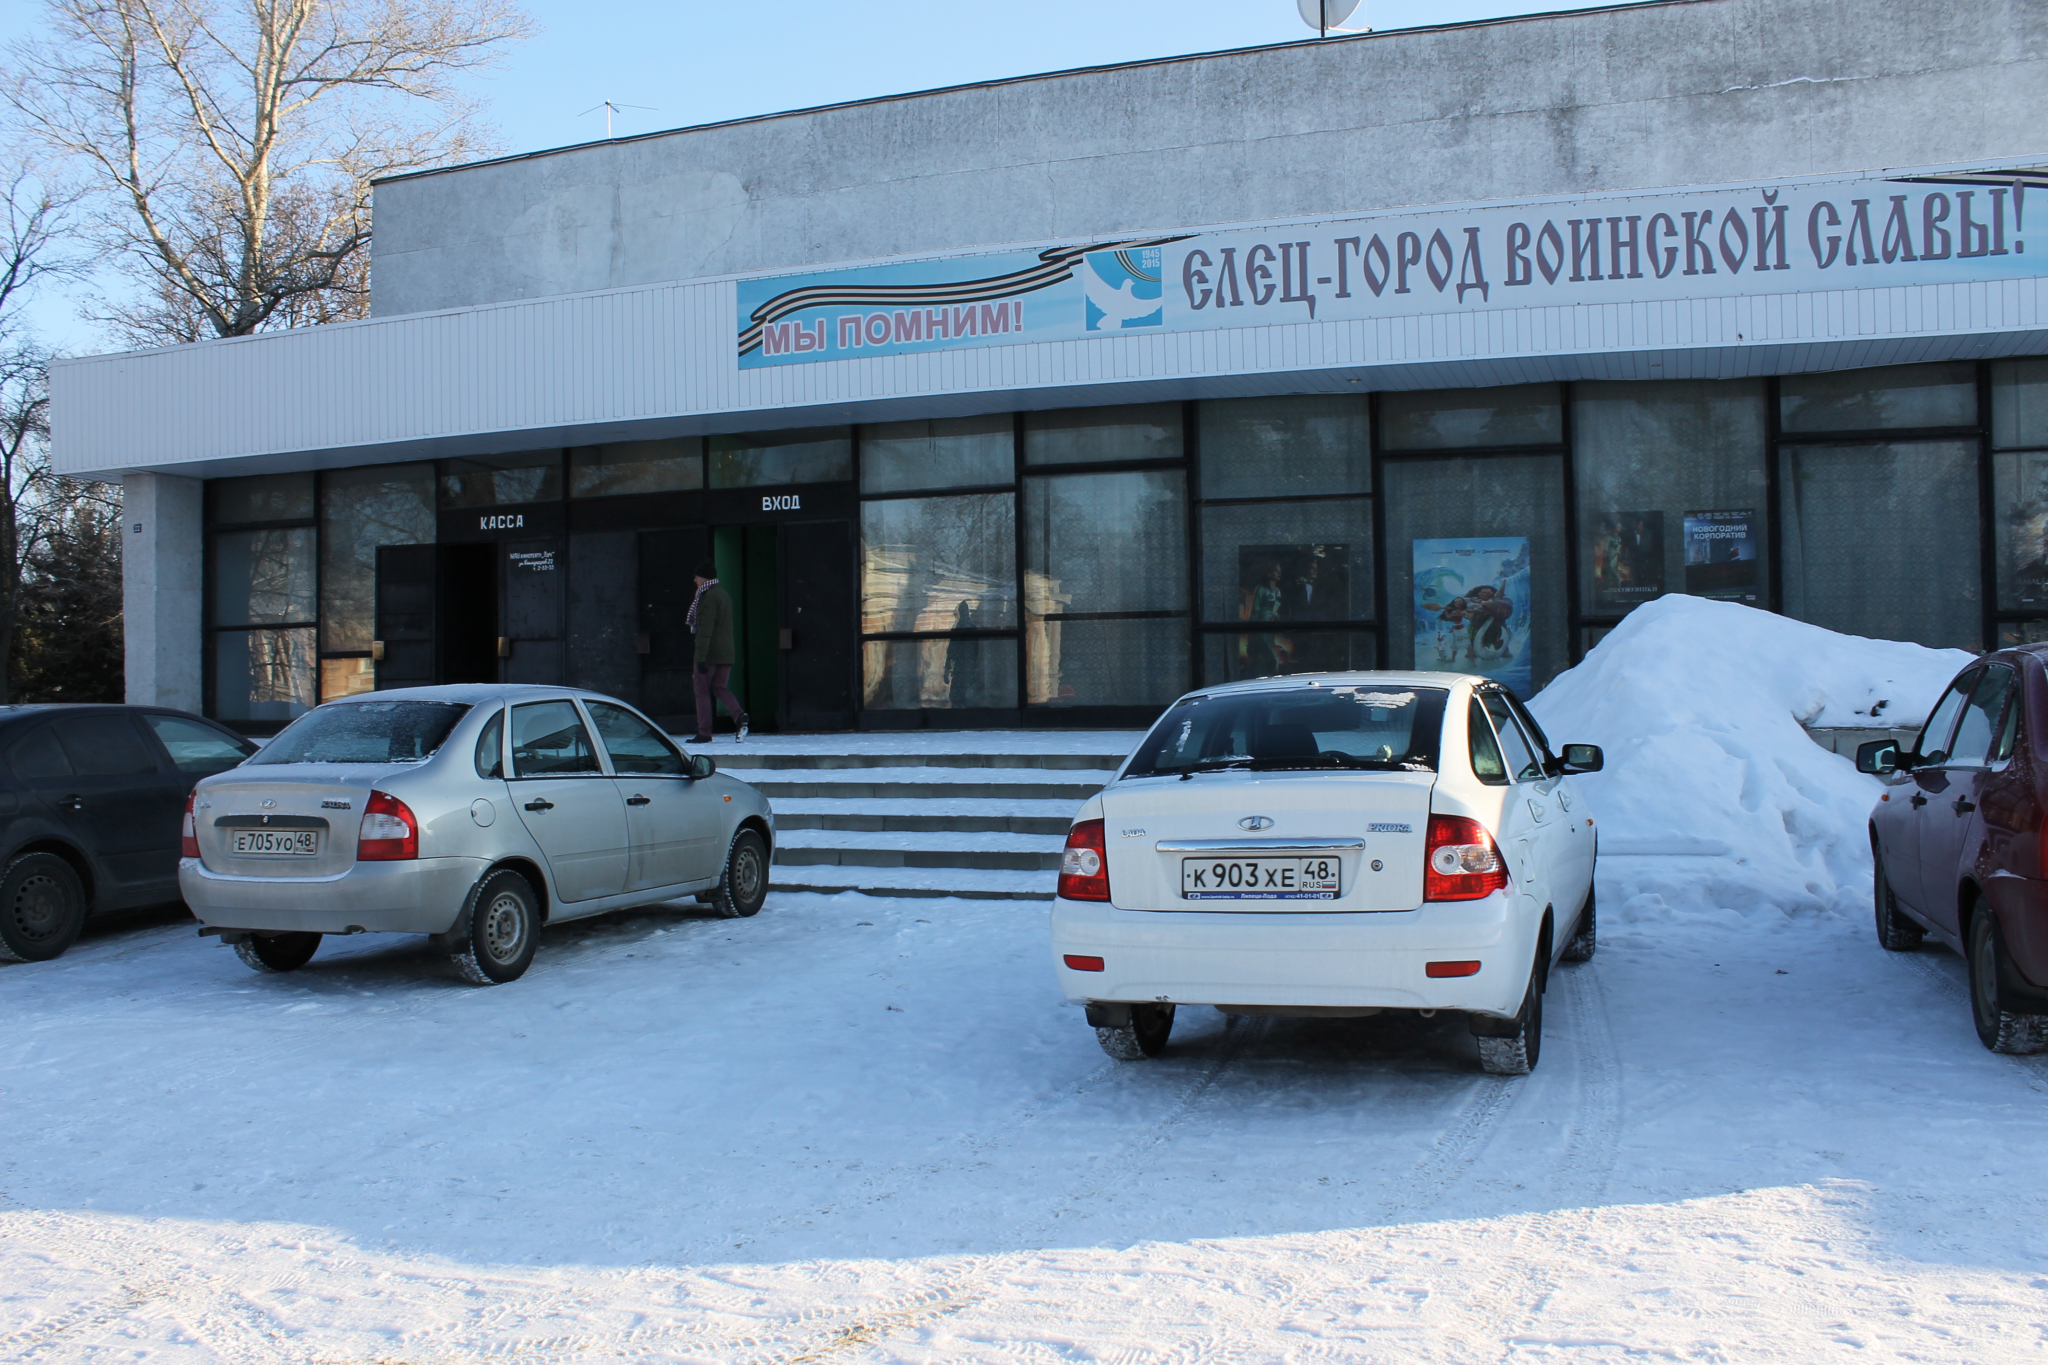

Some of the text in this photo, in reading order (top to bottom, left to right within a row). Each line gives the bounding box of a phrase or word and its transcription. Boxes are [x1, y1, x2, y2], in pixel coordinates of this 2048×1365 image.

[1142, 249, 1160, 259] 1945
[1182, 178, 2025, 320] ЕЛЕЦ-ГОРОД ВОИНСКОЙ СЛАВЫ!
[1142, 258, 1160, 269] 2015
[763, 301, 1023, 355] МЫ ПОМНИМ!
[762, 495, 801, 511] ВХОД
[480, 515, 524, 530] КАССА
[1692, 523, 1748, 533] НОВОГОДНИЙ
[1693, 532, 1747, 540] КОРПОРАТИВ
[1366, 822, 1413, 833] PRIORA
[1121, 829, 1146, 838] LADA
[296, 833, 312, 847] 48
[1304, 861, 1329, 880] 48
[1302, 881, 1322, 889] RUS
